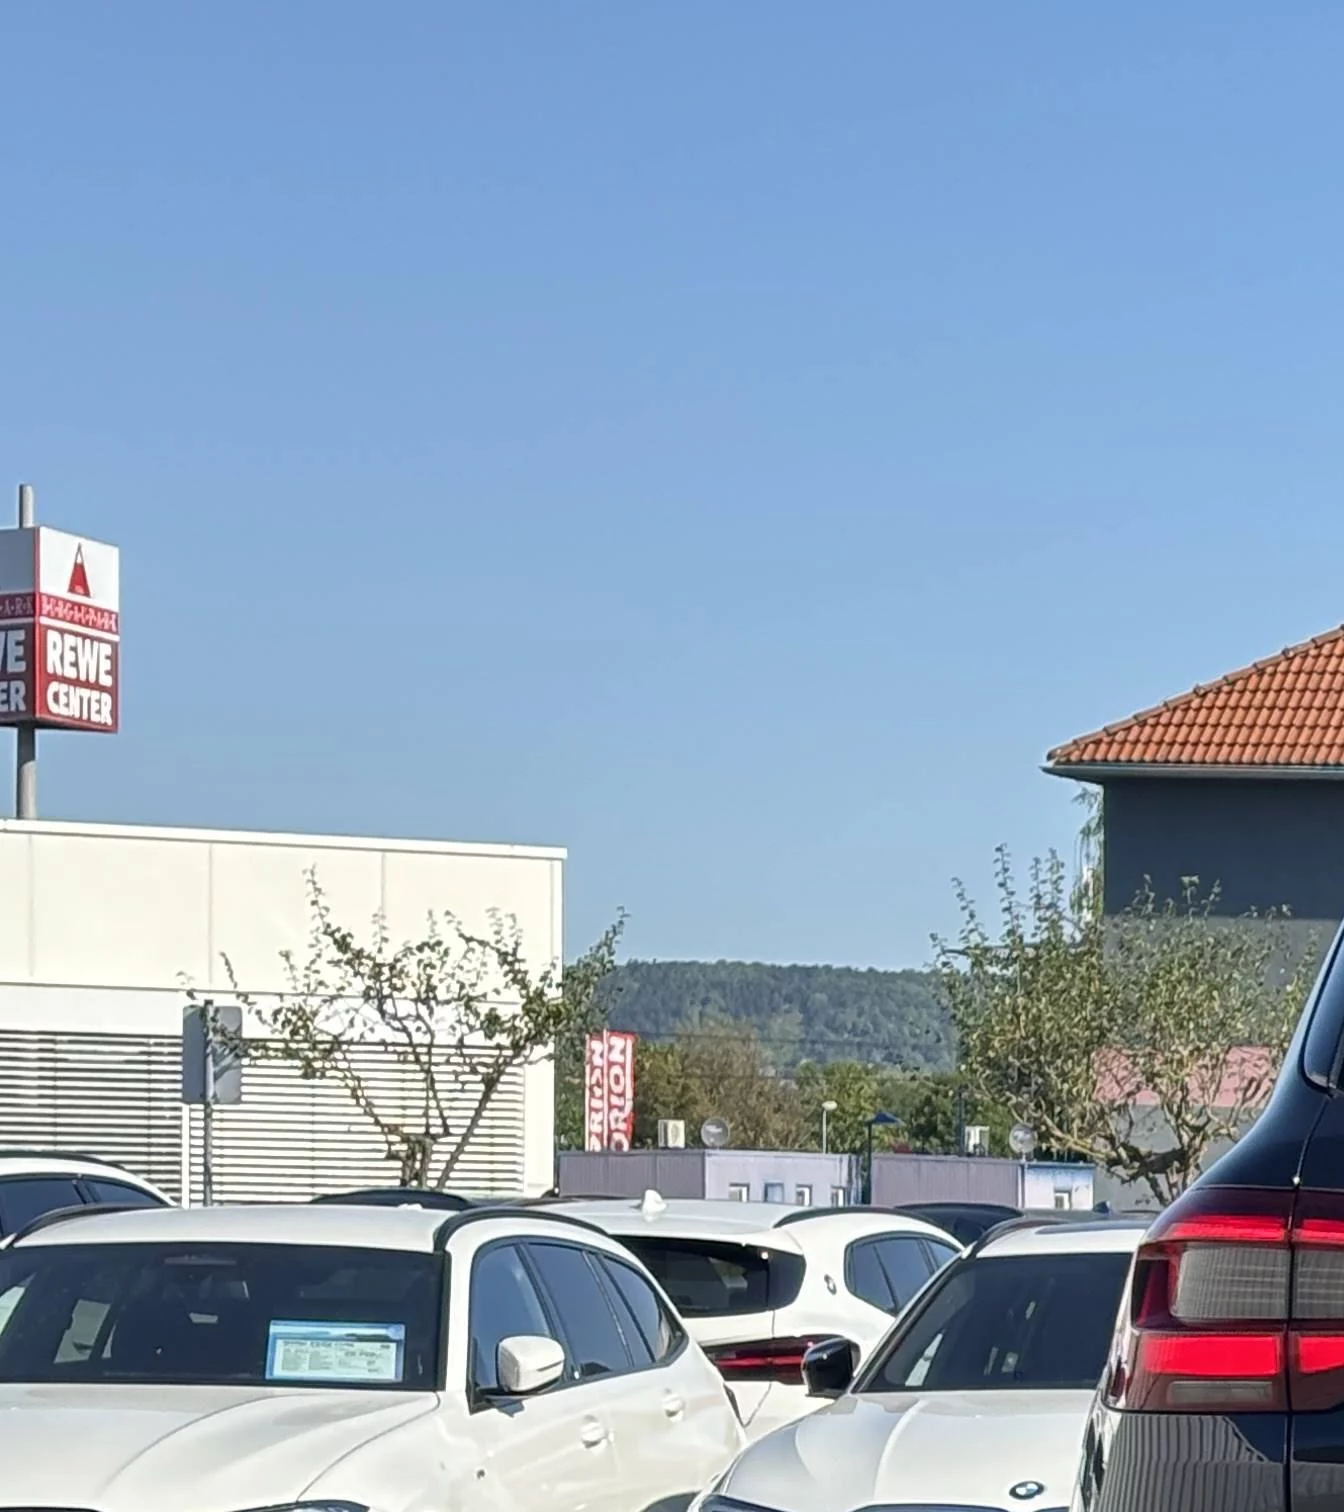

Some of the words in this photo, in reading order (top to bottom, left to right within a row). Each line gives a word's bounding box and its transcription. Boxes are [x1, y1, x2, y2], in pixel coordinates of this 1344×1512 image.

[46, 629, 113, 687] REWE
[46, 681, 112, 726] CENTER
[608, 1035, 629, 1152] ORION
